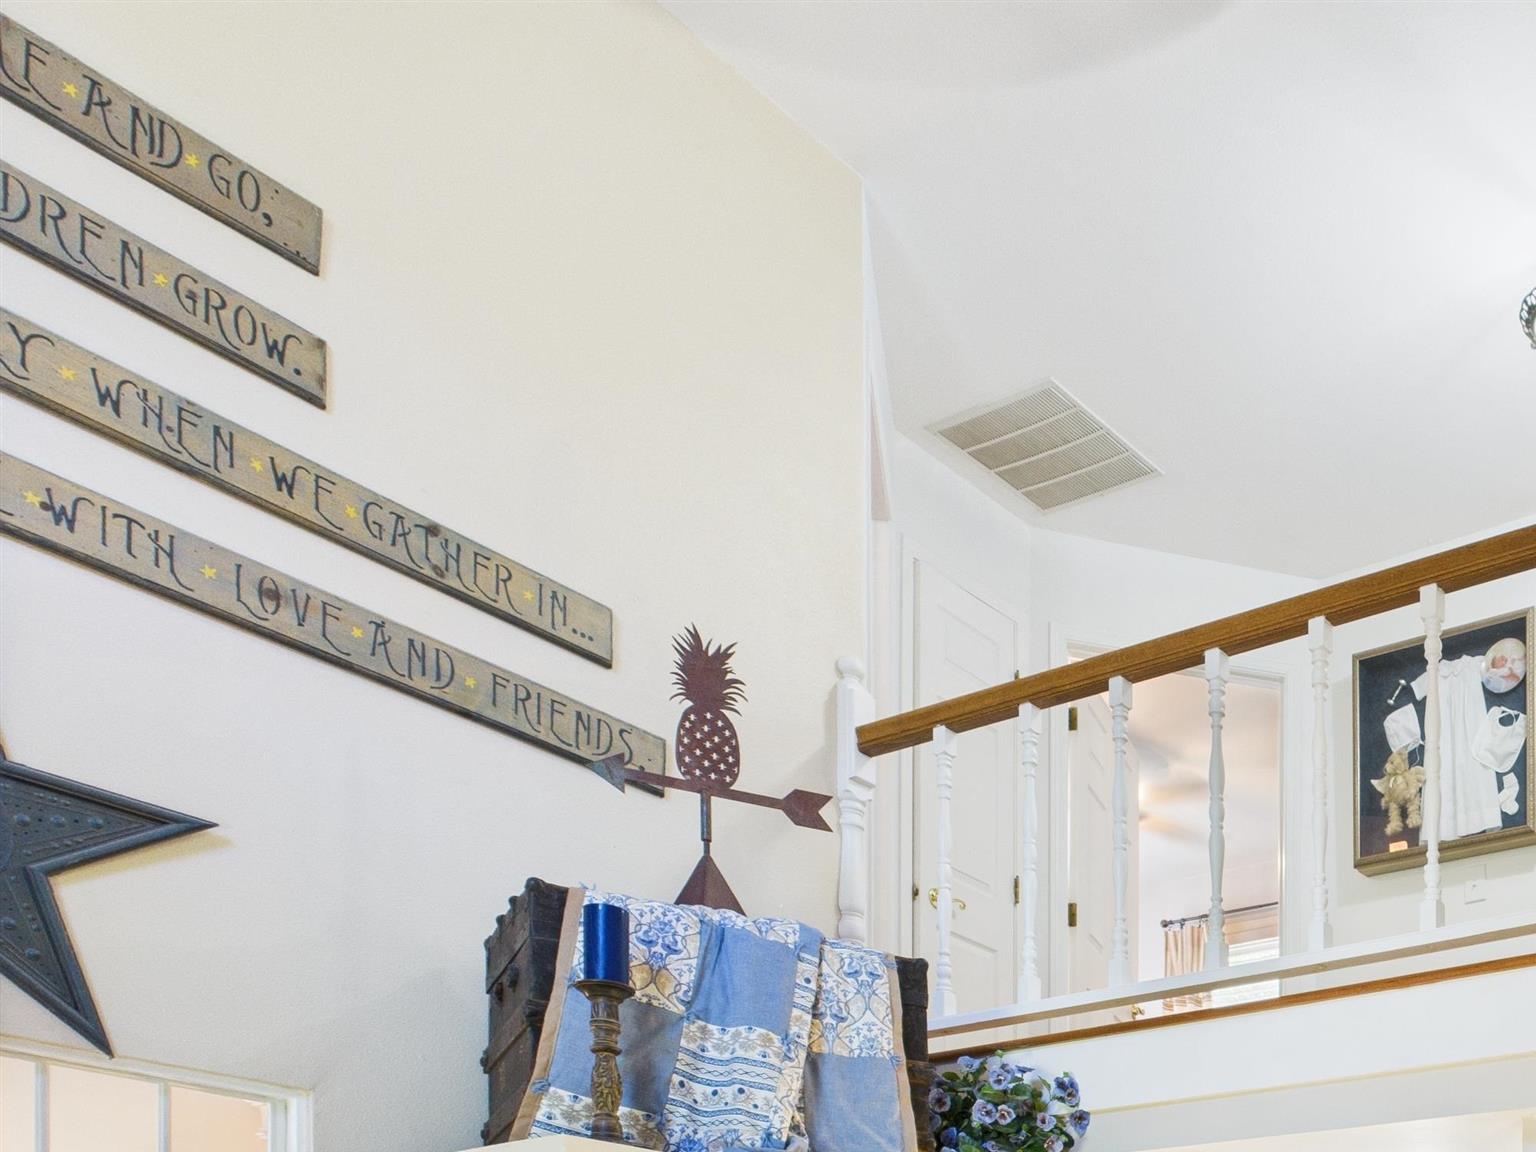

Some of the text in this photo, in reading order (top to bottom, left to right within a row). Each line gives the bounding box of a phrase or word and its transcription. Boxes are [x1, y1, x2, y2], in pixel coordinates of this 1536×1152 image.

[0, 36, 274, 228] E AND GO,
[172, 272, 303, 376] GROW.
[0, 321, 55, 380] Y
[90, 367, 236, 473] WHEN
[268, 455, 344, 531] WE
[362, 501, 523, 616] GATHER
[45, 487, 195, 592] WITH
[234, 562, 352, 657] LOVE
[368, 620, 456, 691] AND
